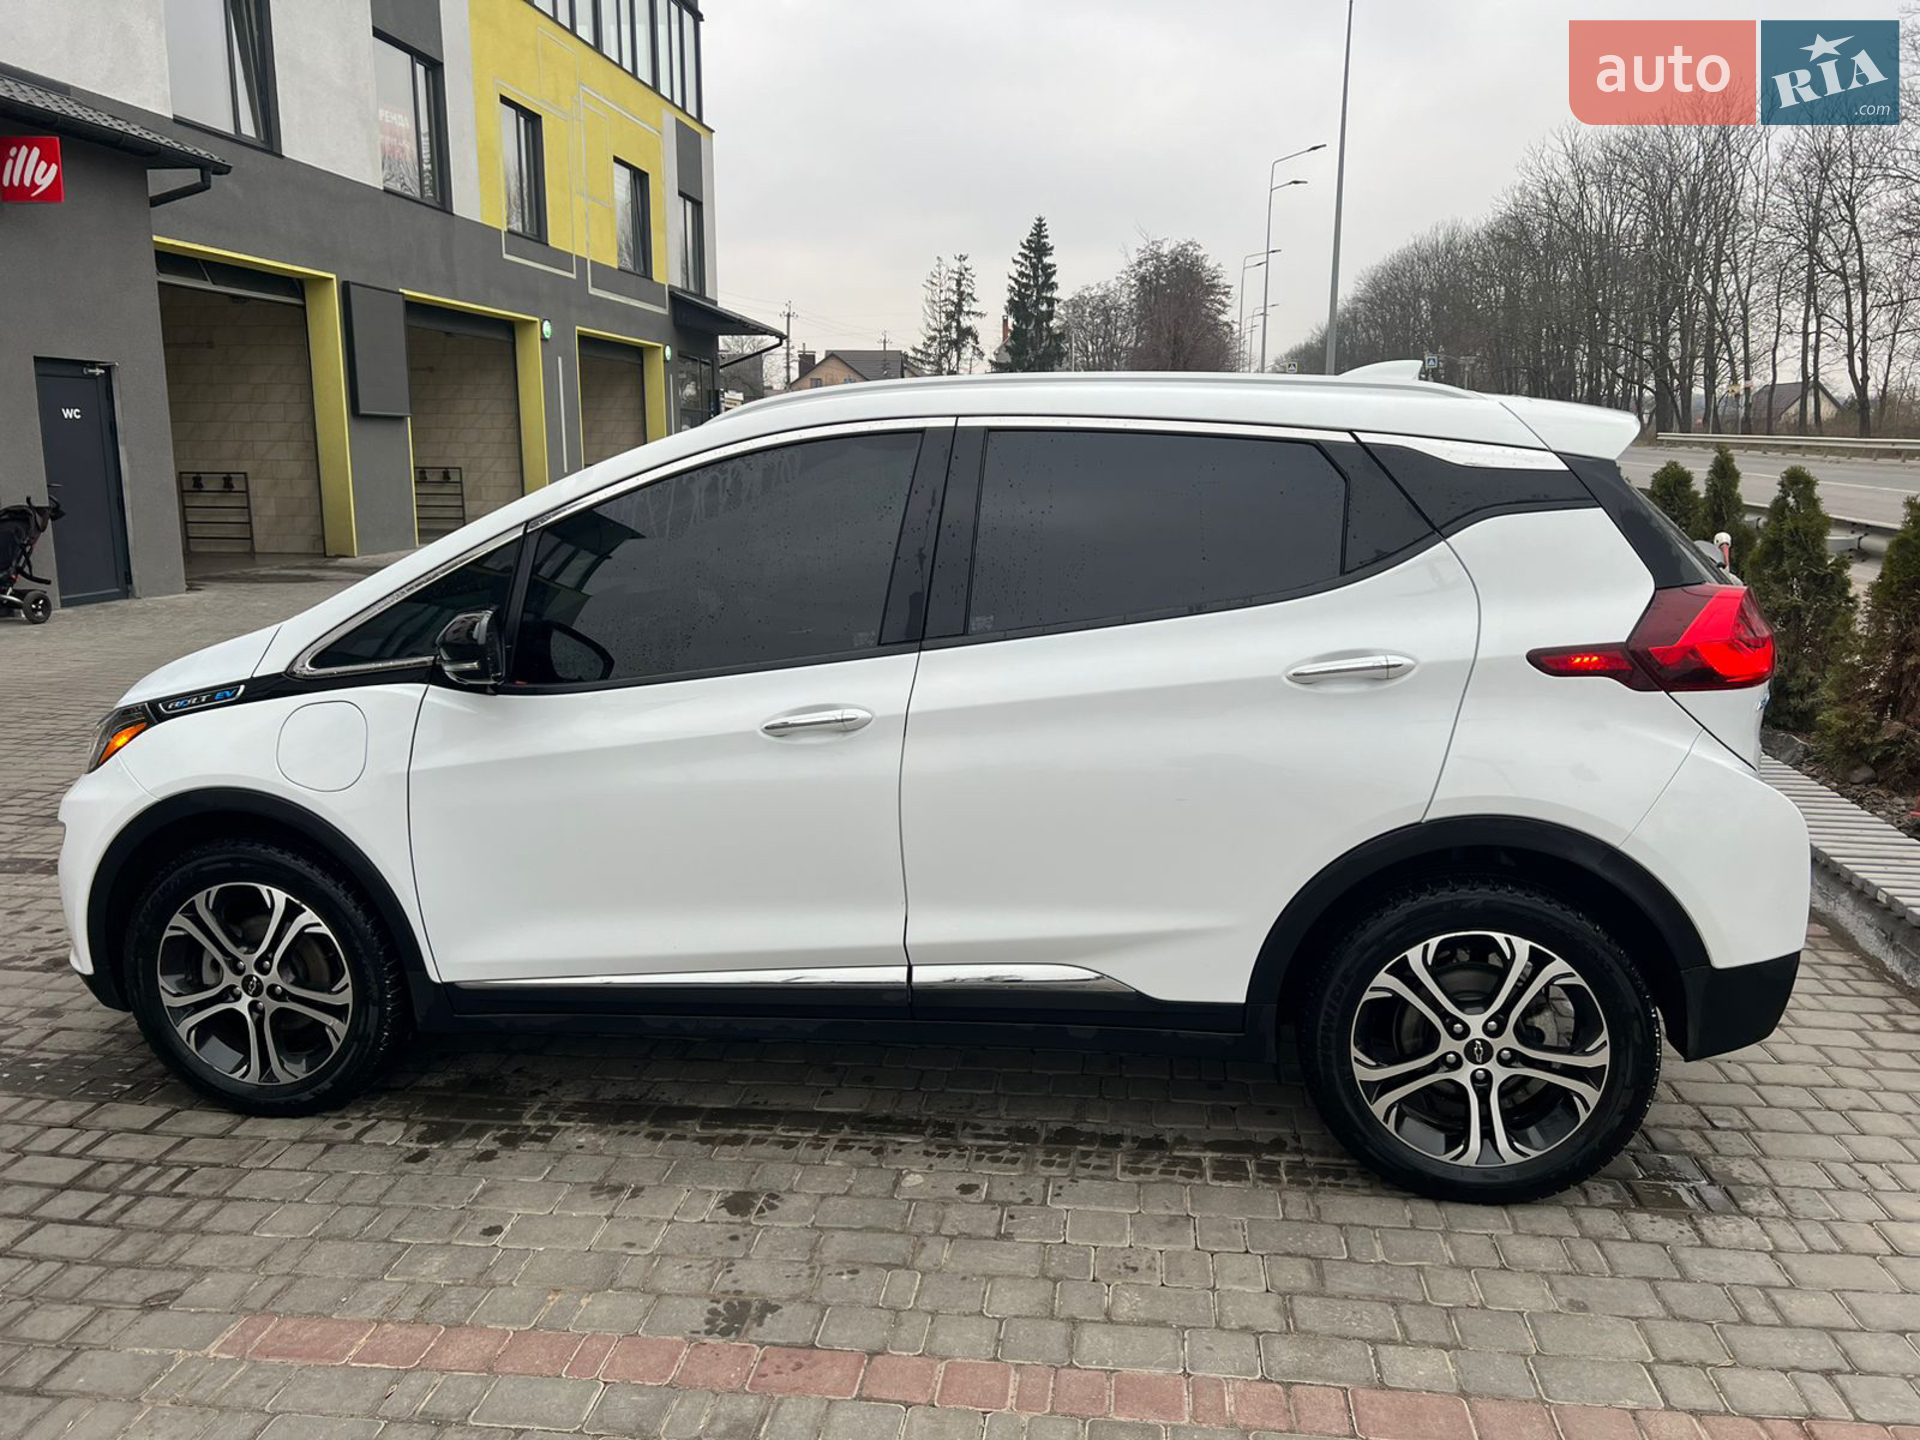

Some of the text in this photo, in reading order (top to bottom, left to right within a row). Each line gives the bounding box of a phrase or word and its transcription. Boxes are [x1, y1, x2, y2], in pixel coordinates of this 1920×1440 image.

[2, 145, 58, 197] illy
[61, 408, 81, 419] WC
[214, 689, 238, 701] EV
